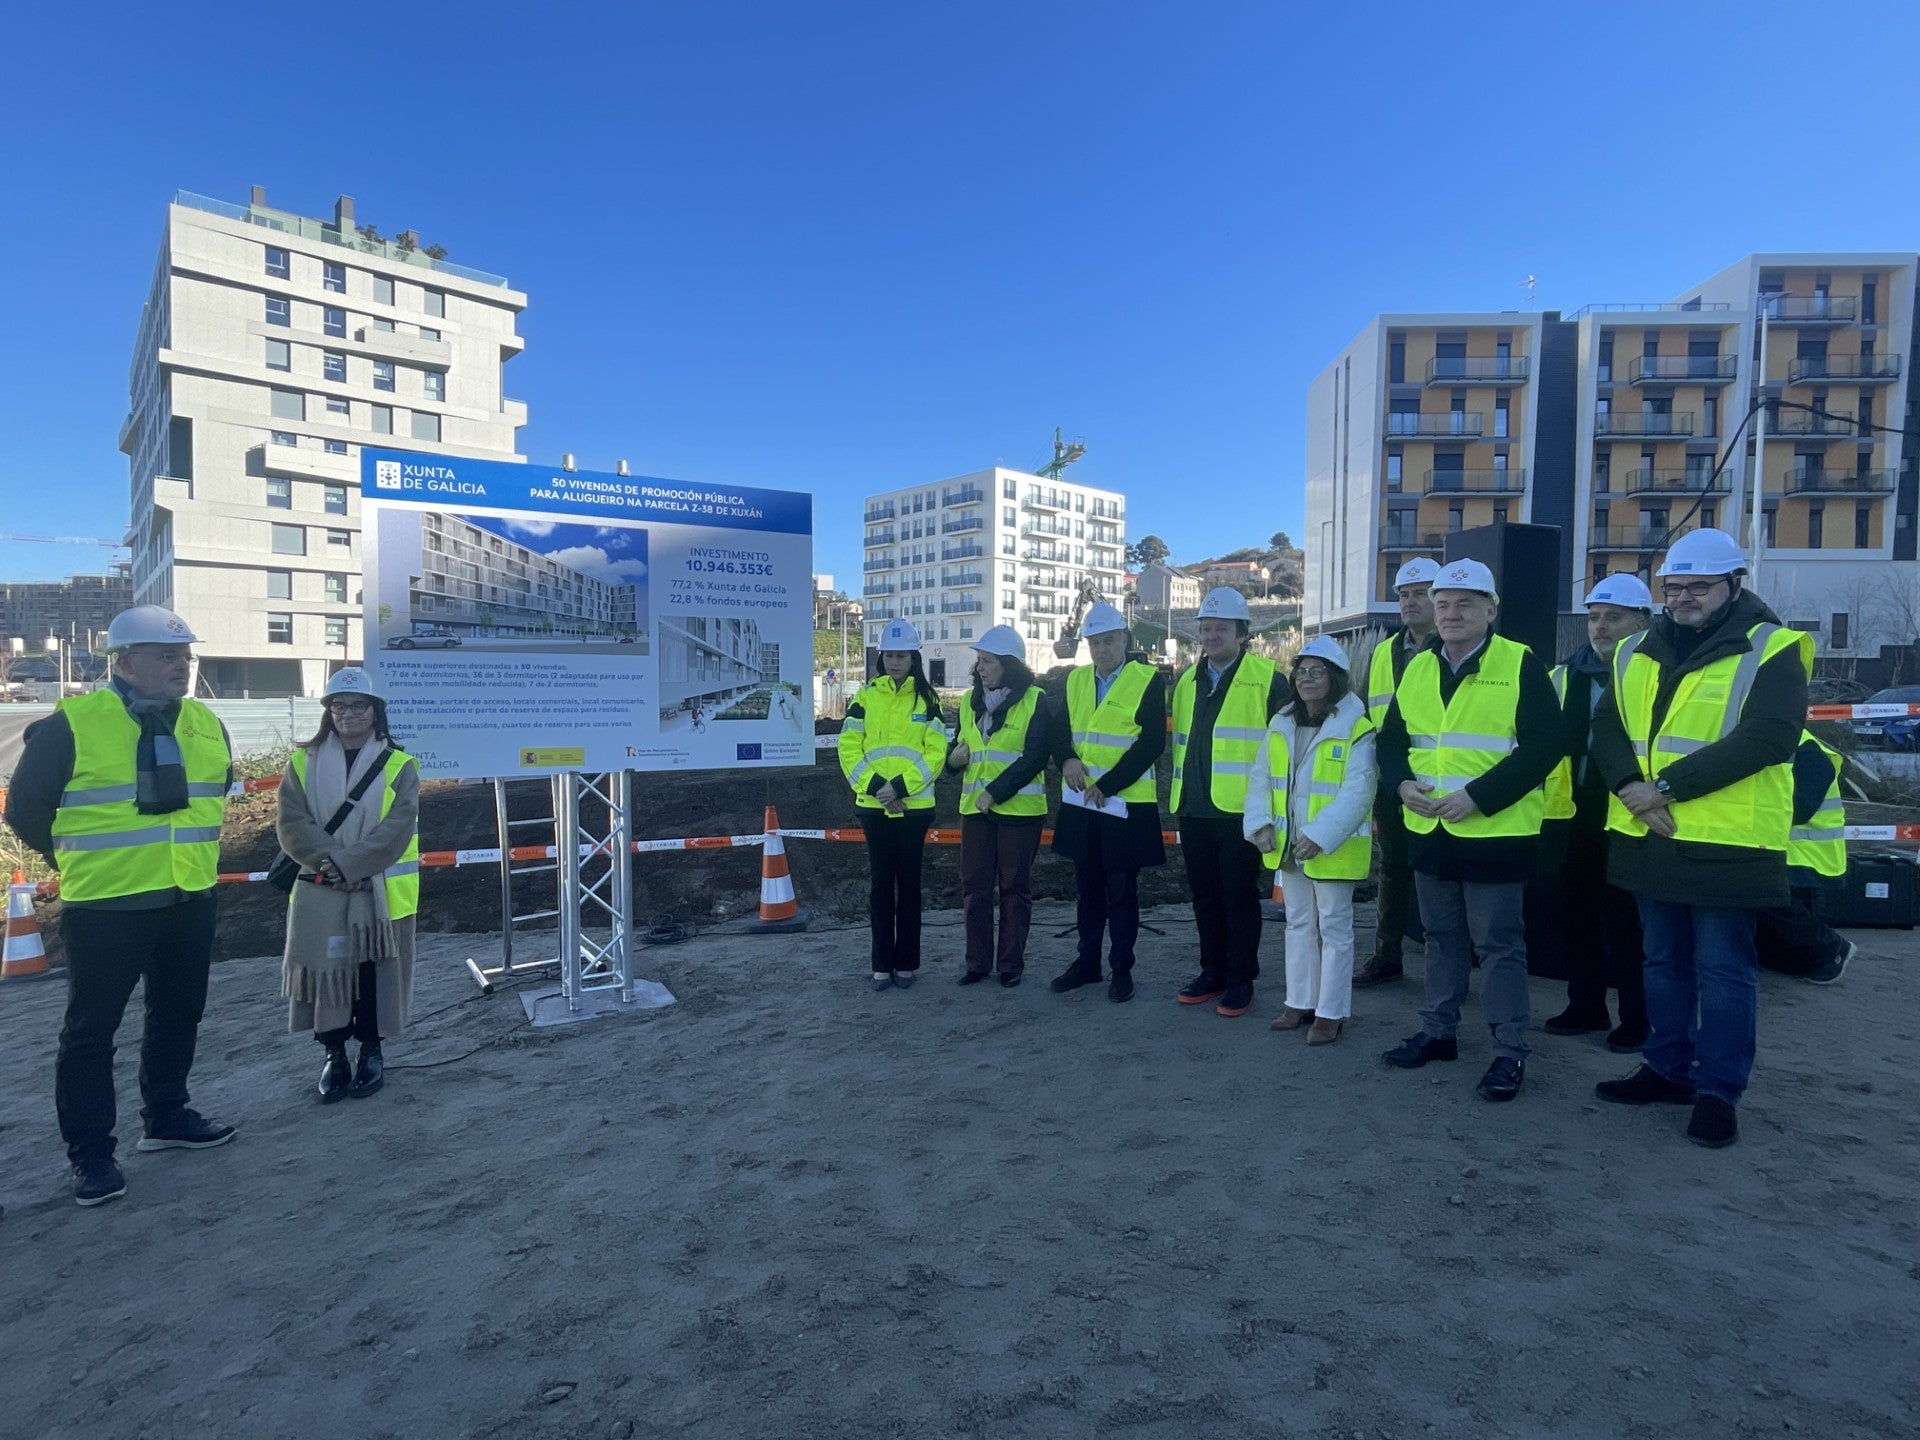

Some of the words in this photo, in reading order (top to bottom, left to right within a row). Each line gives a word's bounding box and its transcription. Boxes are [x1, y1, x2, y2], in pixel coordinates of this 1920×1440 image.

[404, 464, 456, 480] XUNTA
[404, 477, 423, 490] DE
[427, 480, 487, 495] GALICIA
[552, 478, 566, 488] 50
[568, 480, 622, 494] VIVENDAS
[625, 485, 639, 495] DE
[641, 486, 702, 501] PROMOCIÓN
[704, 492, 745, 506] PÚBLICA
[530, 488, 560, 500] PARA
[562, 491, 624, 505] ALUGUEIRO
[627, 497, 643, 507] NA
[645, 499, 690, 512] PARCELA
[692, 504, 713, 514] Z-38
[716, 506, 729, 515] DE
[730, 507, 763, 519] XUXÁN
[690, 547, 769, 562] INVESTIMENTO
[685, 560, 774, 577] 10.946.353€
[671, 580, 693, 590] 77,2
[695, 581, 705, 590] %
[707, 581, 737, 592] Xunta
[740, 583, 752, 592] de
[754, 584, 787, 594] Galicia
[670, 594, 692, 605] 22,8
[695, 595, 705, 604] %
[707, 595, 742, 606] fondos
[744, 598, 789, 609] europeos
[934, 647, 942, 657] 12
[379, 661, 385, 669] 5
[387, 661, 421, 670] plantas
[469, 662, 512, 670] destinadas
[473, 671, 482, 679] 36
[496, 671, 502, 679] 3
[560, 672, 598, 681] adaptadas
[442, 680, 487, 688] mobilidade
[439, 698, 469, 706] portais
[475, 707, 497, 715] parte
